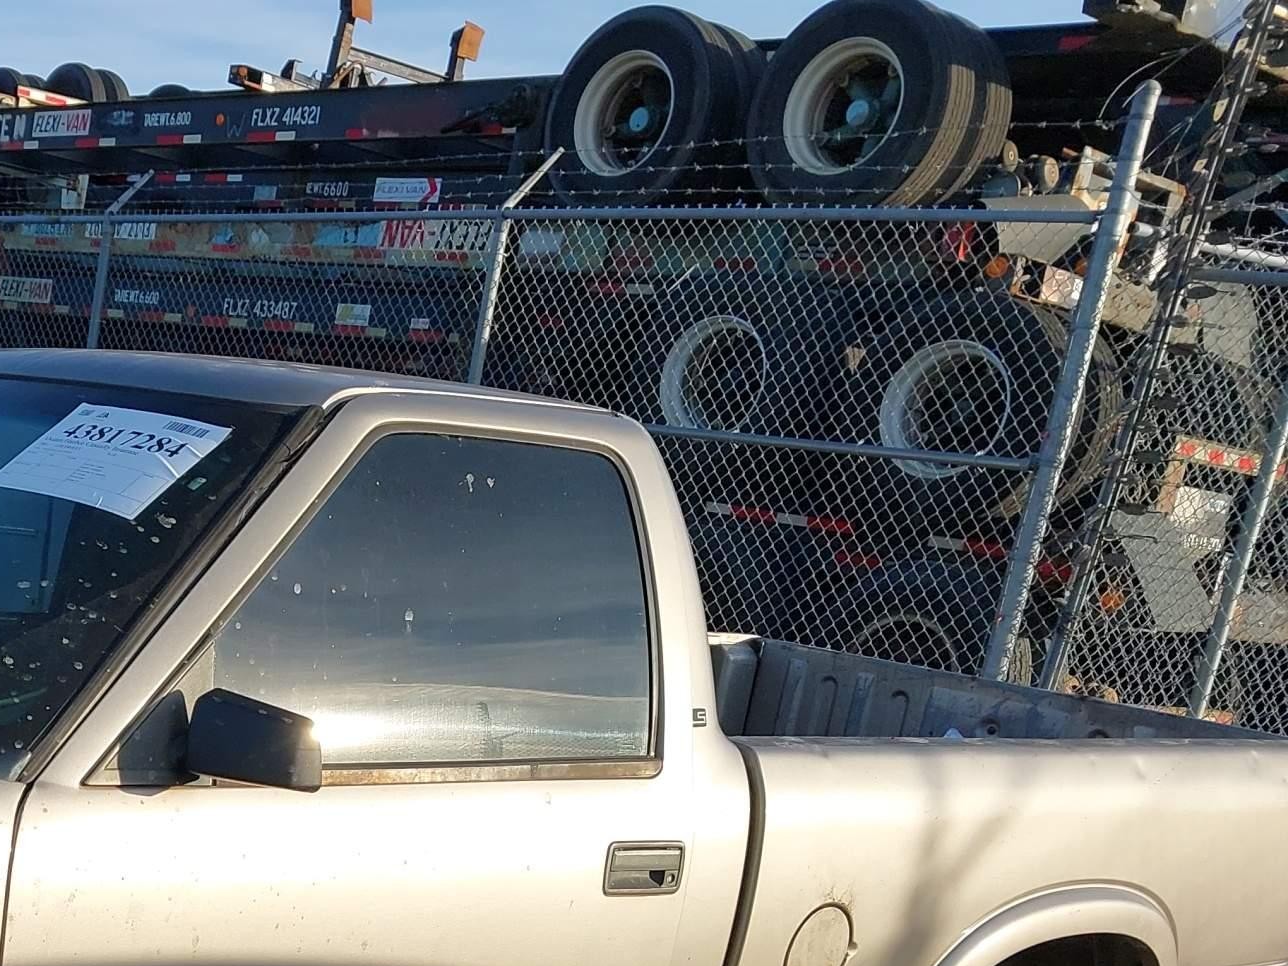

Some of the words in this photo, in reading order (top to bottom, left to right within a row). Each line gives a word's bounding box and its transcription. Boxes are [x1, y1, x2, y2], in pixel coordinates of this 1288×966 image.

[33, 112, 89, 135] FLEXI-VAN
[251, 107, 279, 128] FLXZ
[282, 105, 321, 125] 414321
[323, 181, 349, 197] 6600
[222, 298, 250, 317] FLXZ
[252, 301, 298, 320] 433487
[63, 423, 189, 459] 43817284
